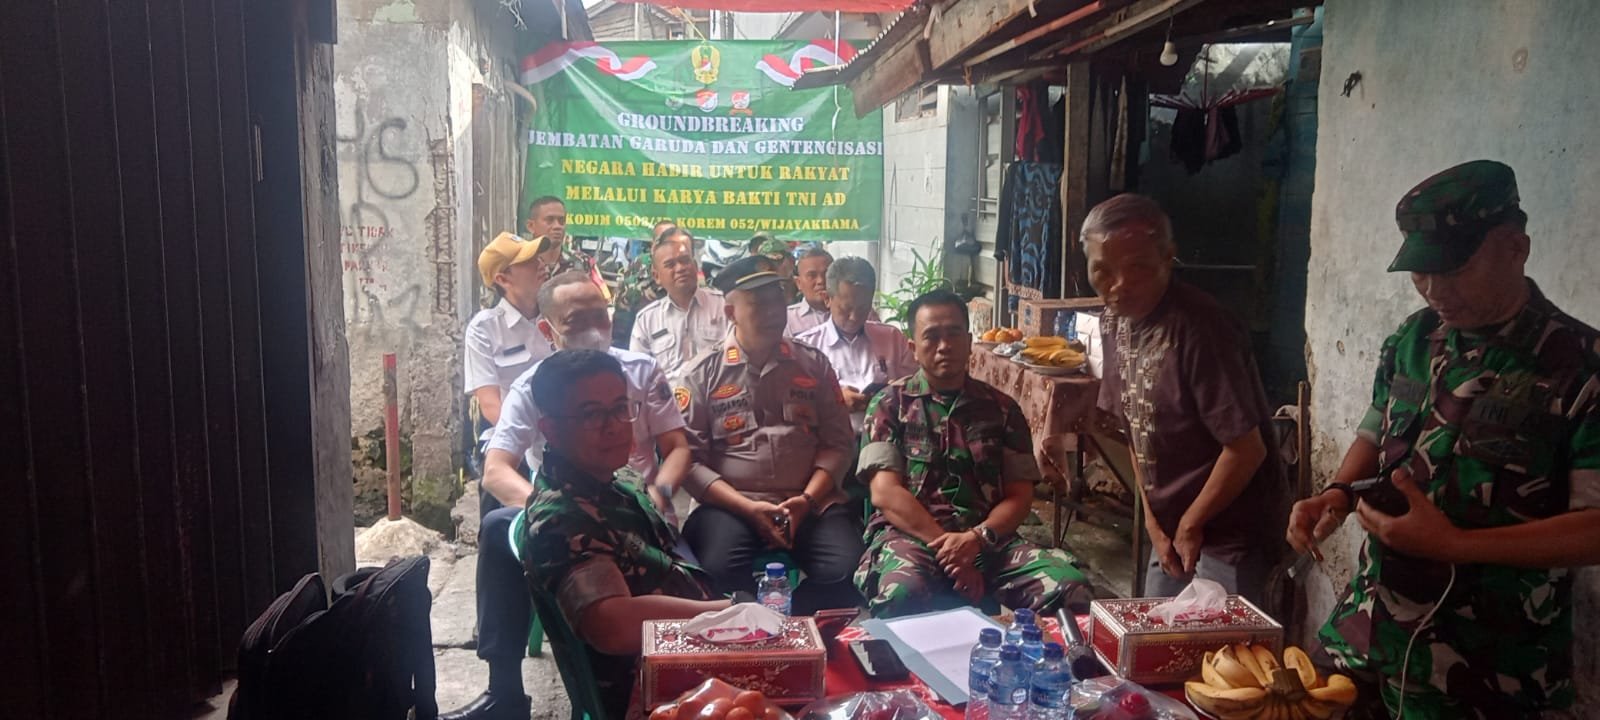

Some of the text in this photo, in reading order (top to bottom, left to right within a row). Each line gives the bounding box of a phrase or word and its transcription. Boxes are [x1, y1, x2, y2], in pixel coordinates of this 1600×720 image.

[617, 112, 804, 133] GROUNDBREAKING
[527, 130, 883, 156] JEMBATAN GARUDA DAN GENTENGISASI
[561, 159, 850, 181] NEGARA HADIR UNTUK RAKYAT
[566, 185, 847, 206] MELALUI KARYA BAKTI TNI AD
[565, 213, 611, 226] KODIM
[676, 216, 726, 229] KOREM
[730, 217, 860, 232] 052/WIJAYAKRAMA
